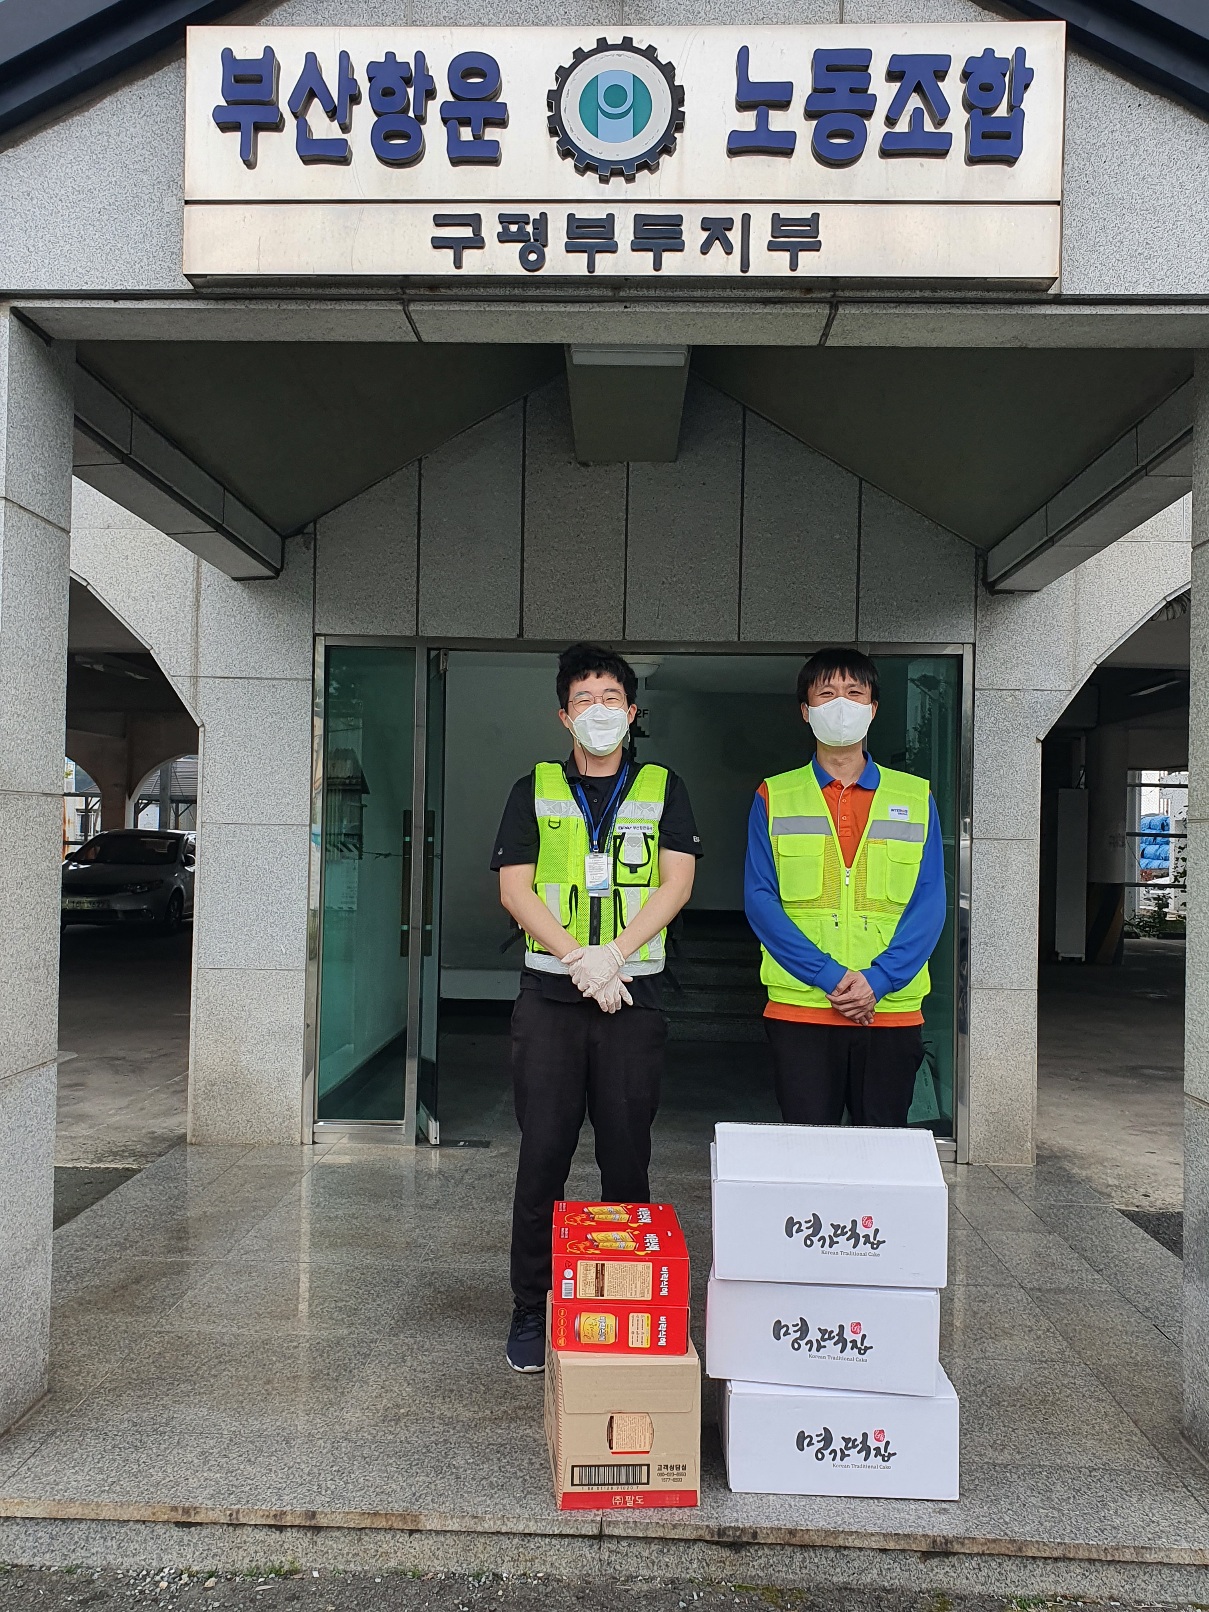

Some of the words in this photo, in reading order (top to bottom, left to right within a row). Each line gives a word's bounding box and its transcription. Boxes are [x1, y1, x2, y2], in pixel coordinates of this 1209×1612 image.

[212, 45, 509, 168] 부산항운
[726, 45, 1034, 167] 노동조합
[431, 212, 822, 273] 구평부두지부
[785, 1212, 886, 1250] 명가떡집
[773, 1316, 873, 1355] 명가떡집
[827, 1354, 855, 1362] Traditional
[796, 1426, 897, 1463] 명가떡집
[657, 1463, 687, 1472] 고객상담실
